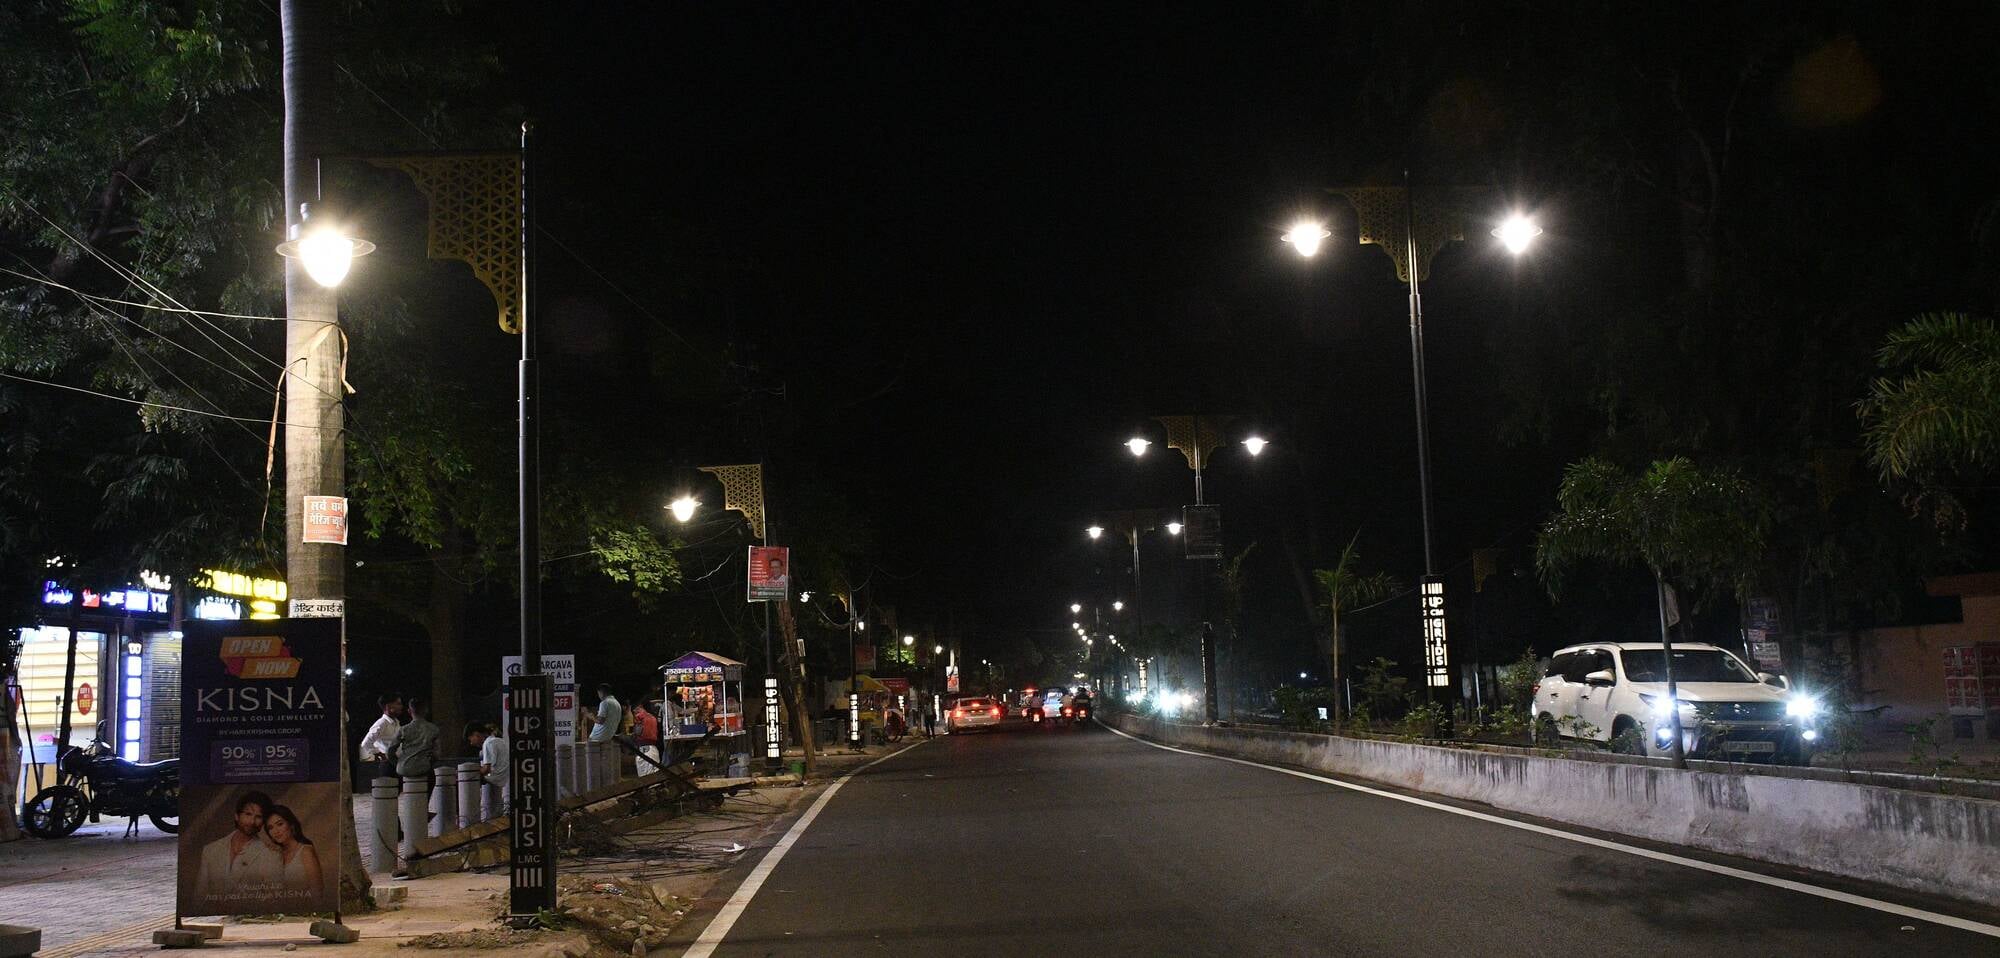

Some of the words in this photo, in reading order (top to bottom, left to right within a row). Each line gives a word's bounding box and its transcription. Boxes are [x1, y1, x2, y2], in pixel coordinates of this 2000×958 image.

[1428, 596, 1444, 608] UP
[1429, 608, 1444, 616] CM
[229, 639, 272, 654] OPEN
[1432, 618, 1444, 666] GRIDS
[254, 661, 291, 676] NOW
[541, 660, 572, 669] ARGAVA
[196, 685, 324, 711] KISNA
[765, 688, 778, 698] UP
[196, 715, 239, 724] DIAMOND
[277, 713, 325, 721] JEWELLERY
[768, 705, 776, 742] GRIDS
[516, 739, 540, 750] CM
[521, 758, 536, 848] GRIDS
[518, 854, 540, 864] LMC
